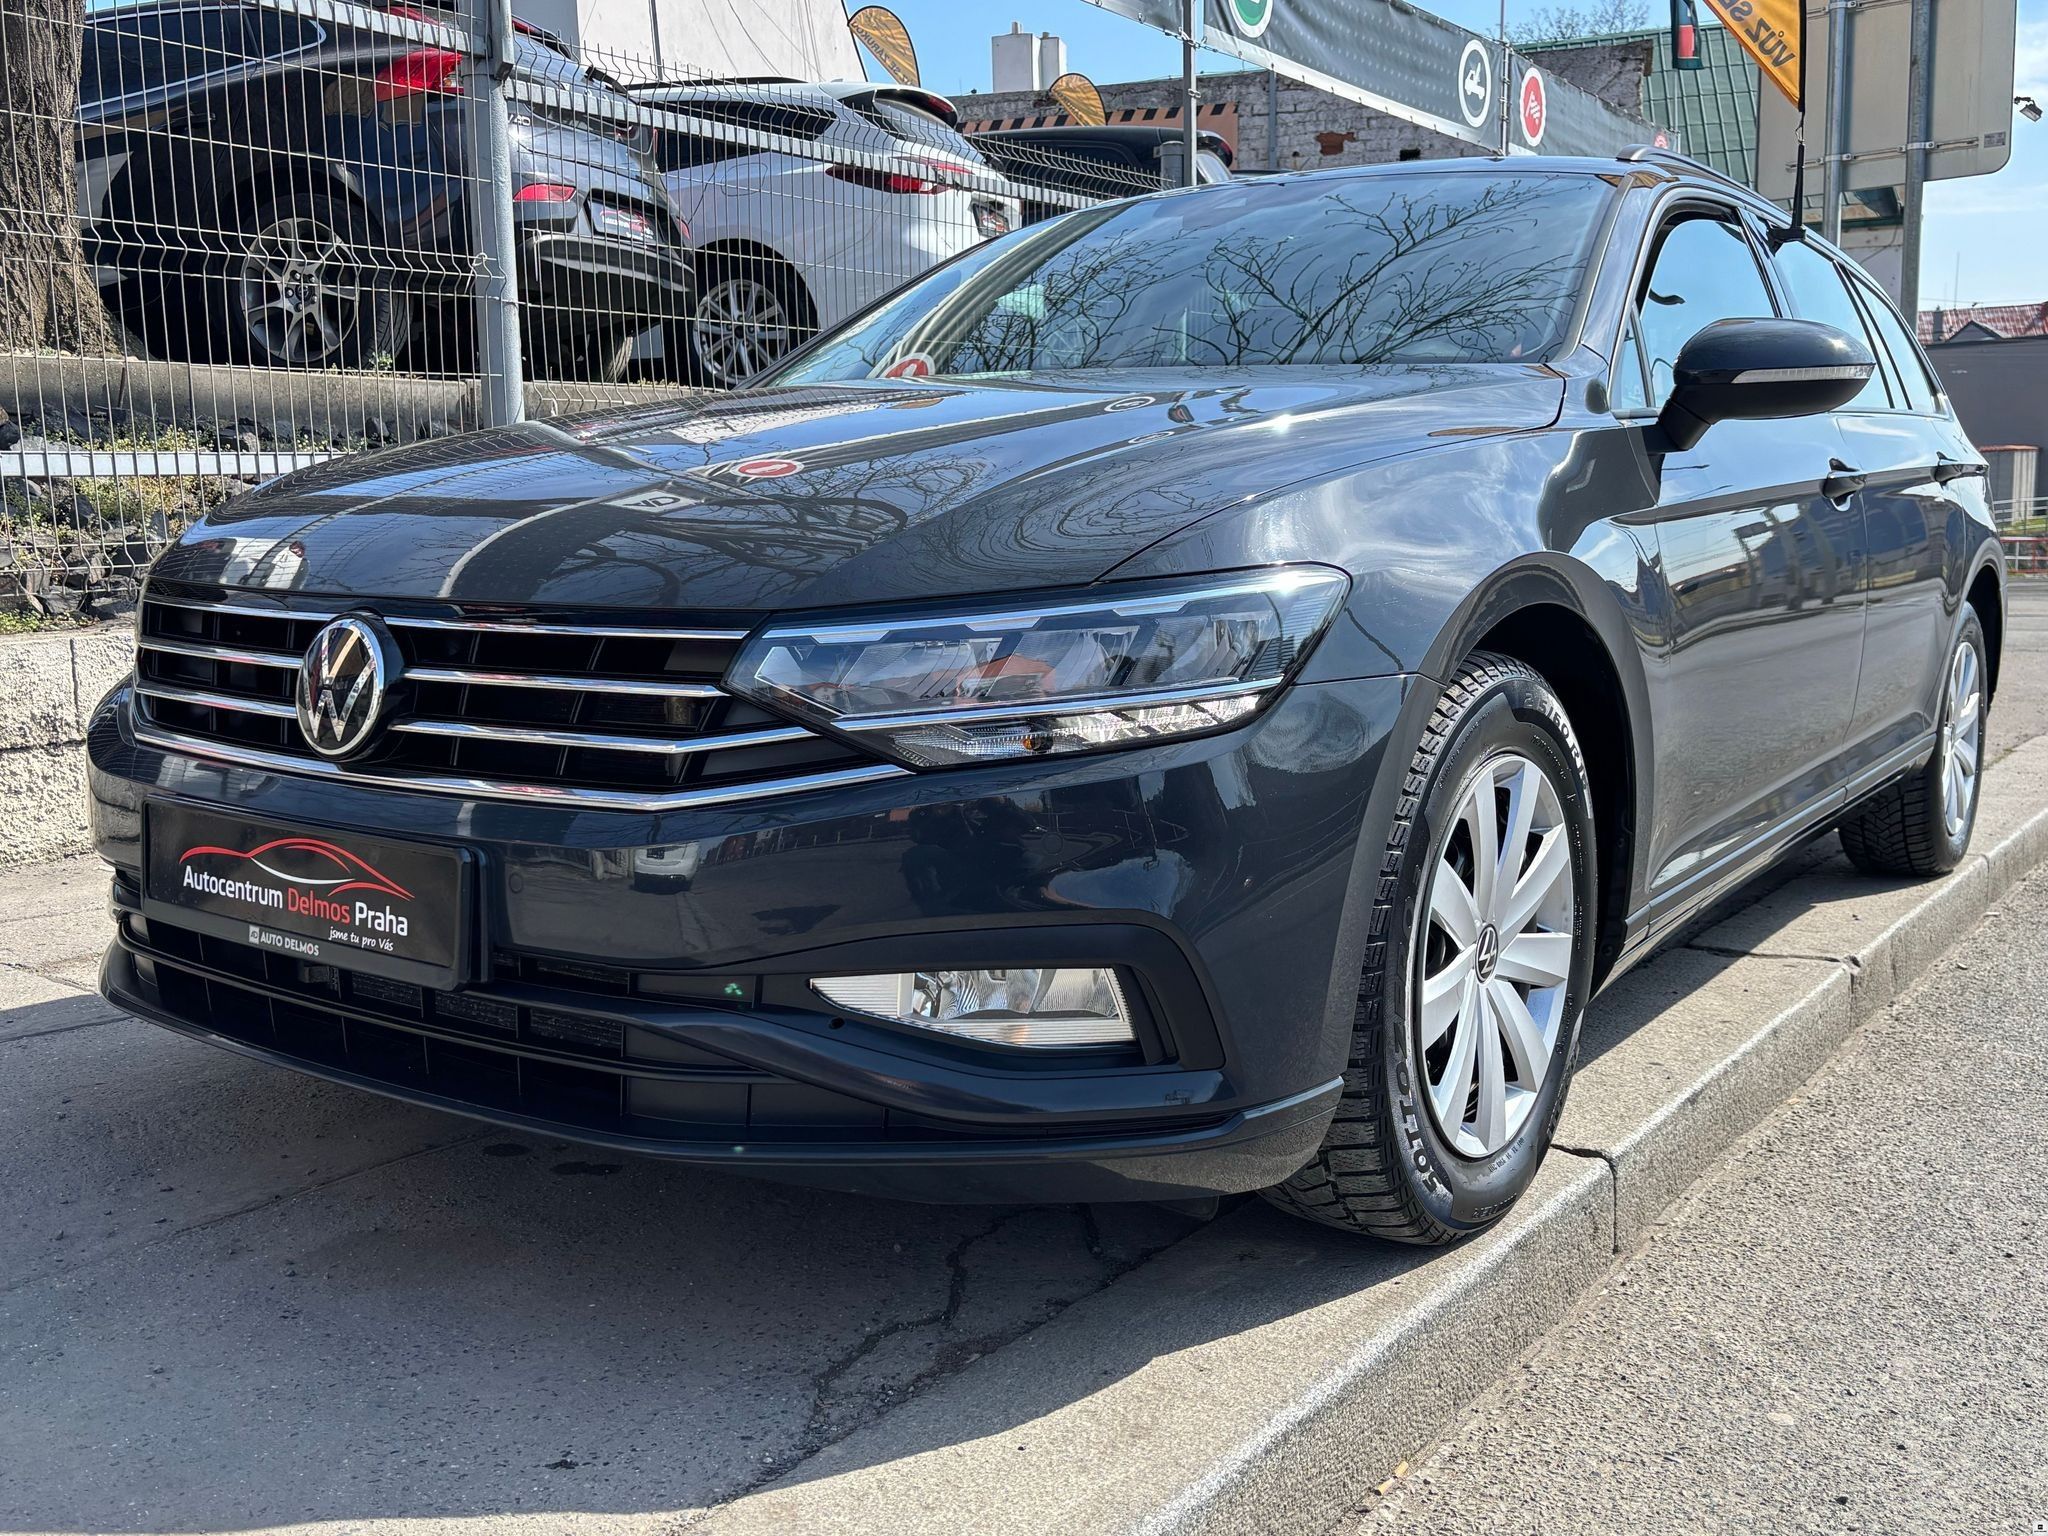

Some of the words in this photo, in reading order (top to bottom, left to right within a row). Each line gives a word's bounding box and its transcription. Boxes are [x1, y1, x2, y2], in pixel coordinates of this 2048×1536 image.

[183, 865, 283, 909] Autocentrum
[287, 887, 350, 924] Delmos
[355, 902, 408, 936] Praha
[260, 931, 283, 947] AUTO
[284, 936, 320, 956] DELMOS
[328, 926, 348, 941] jsme
[350, 932, 360, 943] tu
[361, 936, 376, 948] pro
[379, 938, 394, 951] Vás
